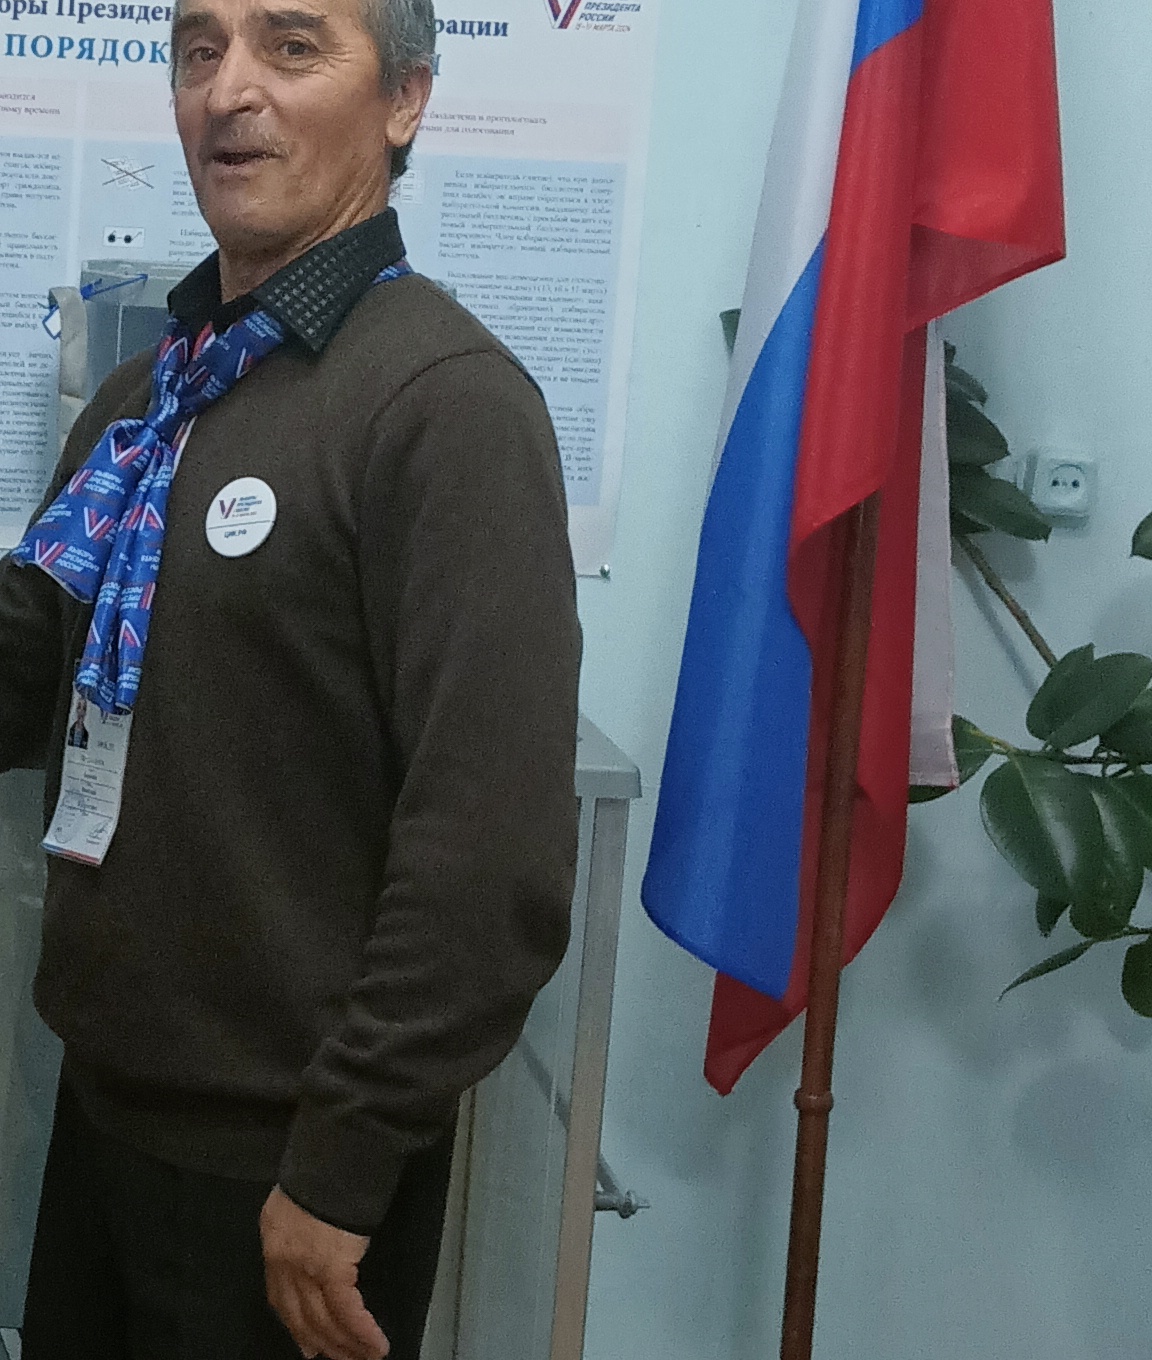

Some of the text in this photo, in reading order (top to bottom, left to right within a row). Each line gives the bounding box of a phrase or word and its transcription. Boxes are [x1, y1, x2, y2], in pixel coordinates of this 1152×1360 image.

[584, 1, 642, 13] ПРЕЗИДЕНТА
[579, 12, 616, 23] РОССИИ
[5, 33, 169, 67] ПОРЯДОК
